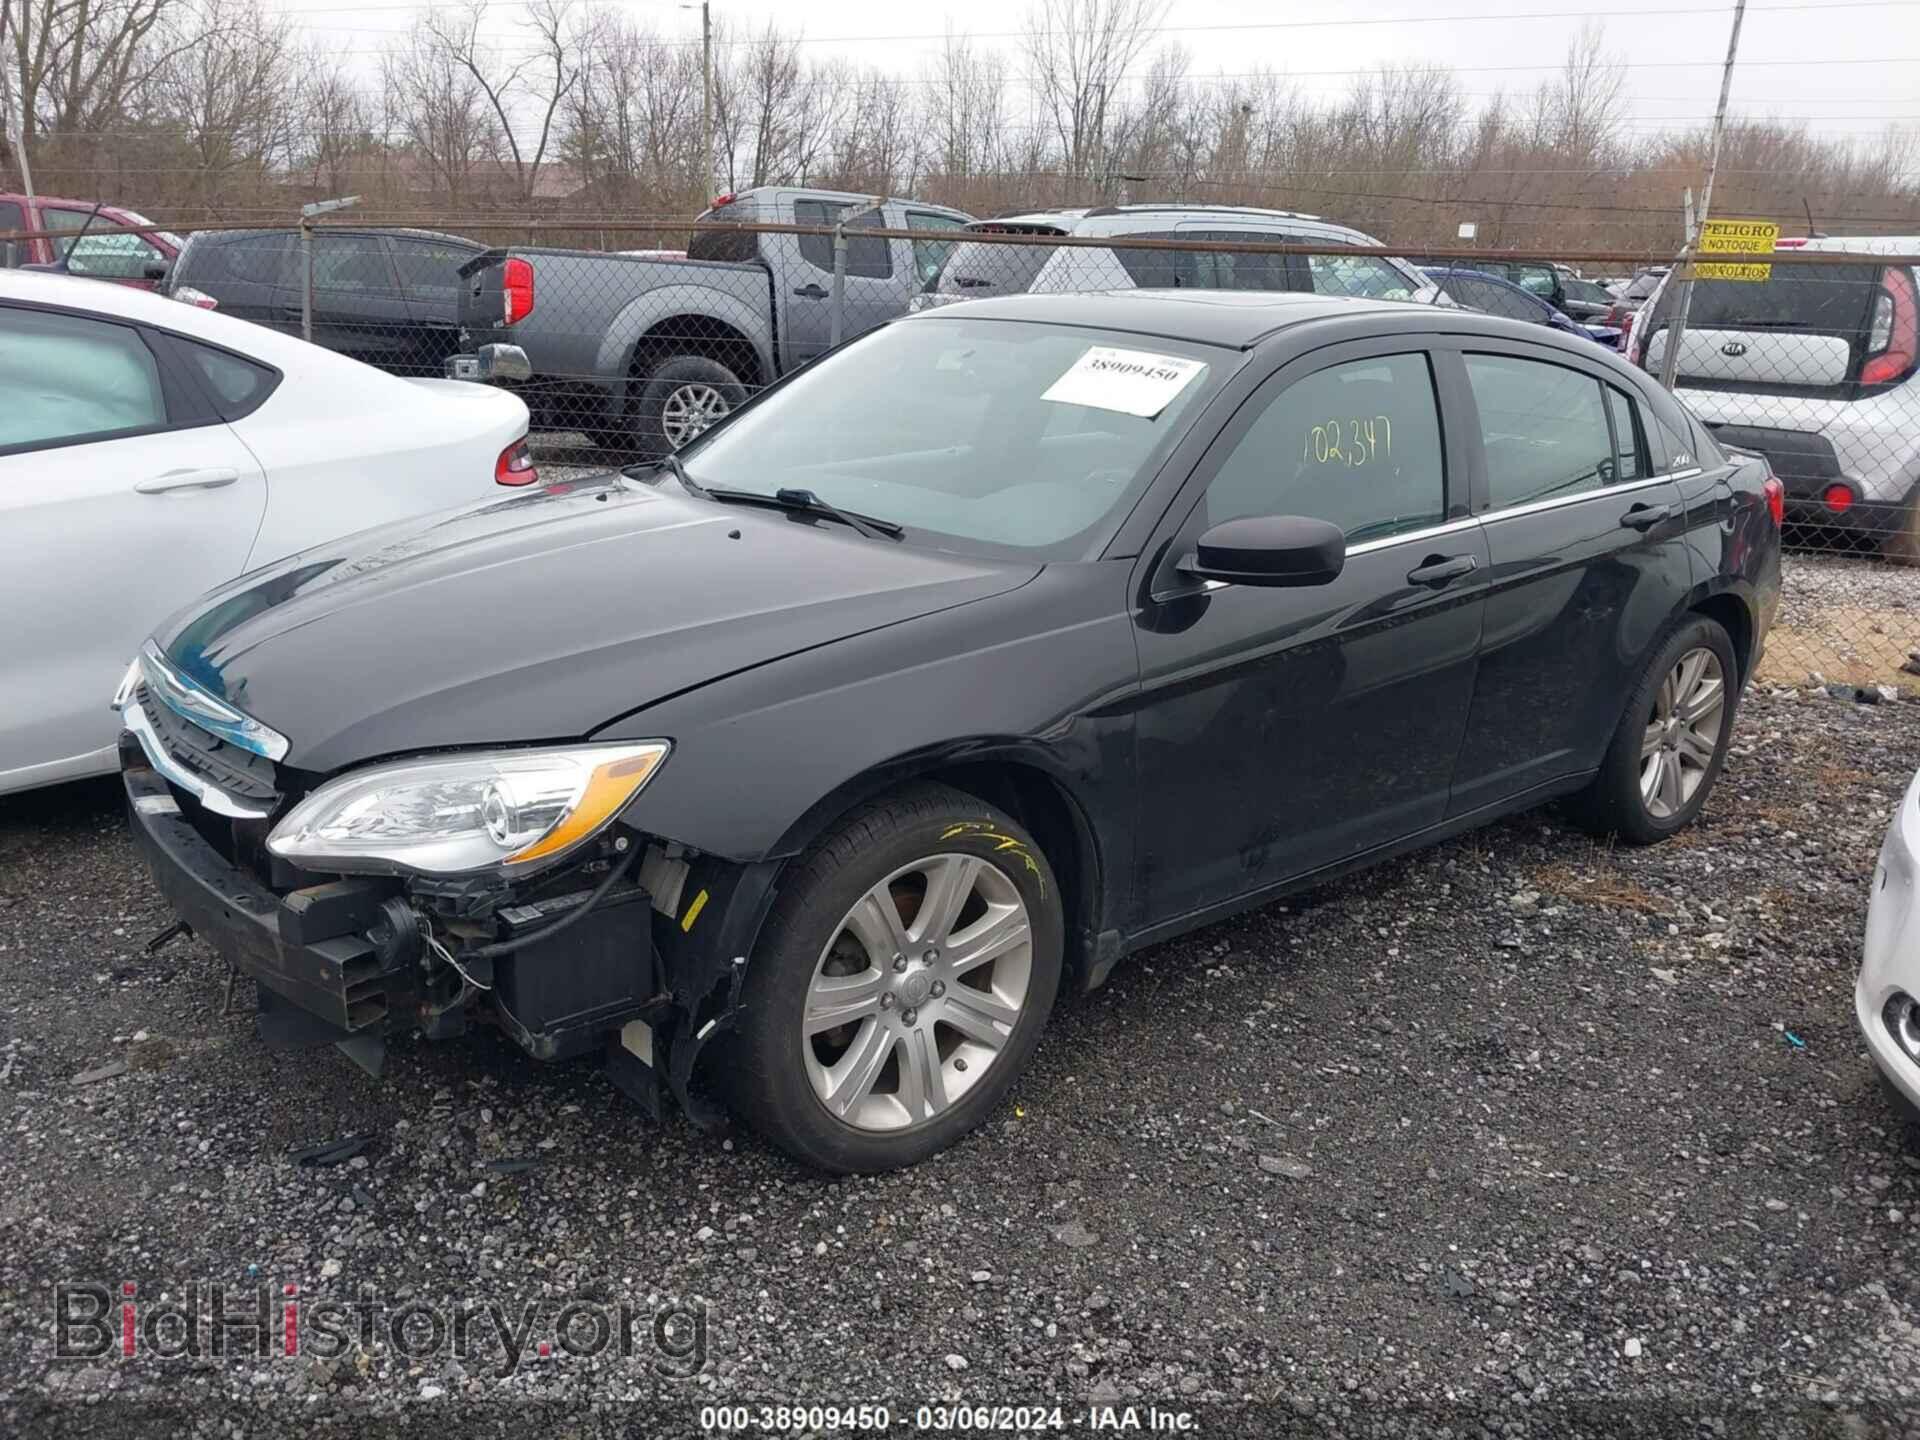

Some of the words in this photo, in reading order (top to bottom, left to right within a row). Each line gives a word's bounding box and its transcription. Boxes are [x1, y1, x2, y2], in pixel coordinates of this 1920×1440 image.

[1703, 223, 1775, 237] PELIGRO
[1724, 239, 1761, 251] TOQUE
[1723, 343, 1743, 353] KIA
[1091, 359, 1179, 381] 38909450
[1303, 415, 1391, 468] 102,347
